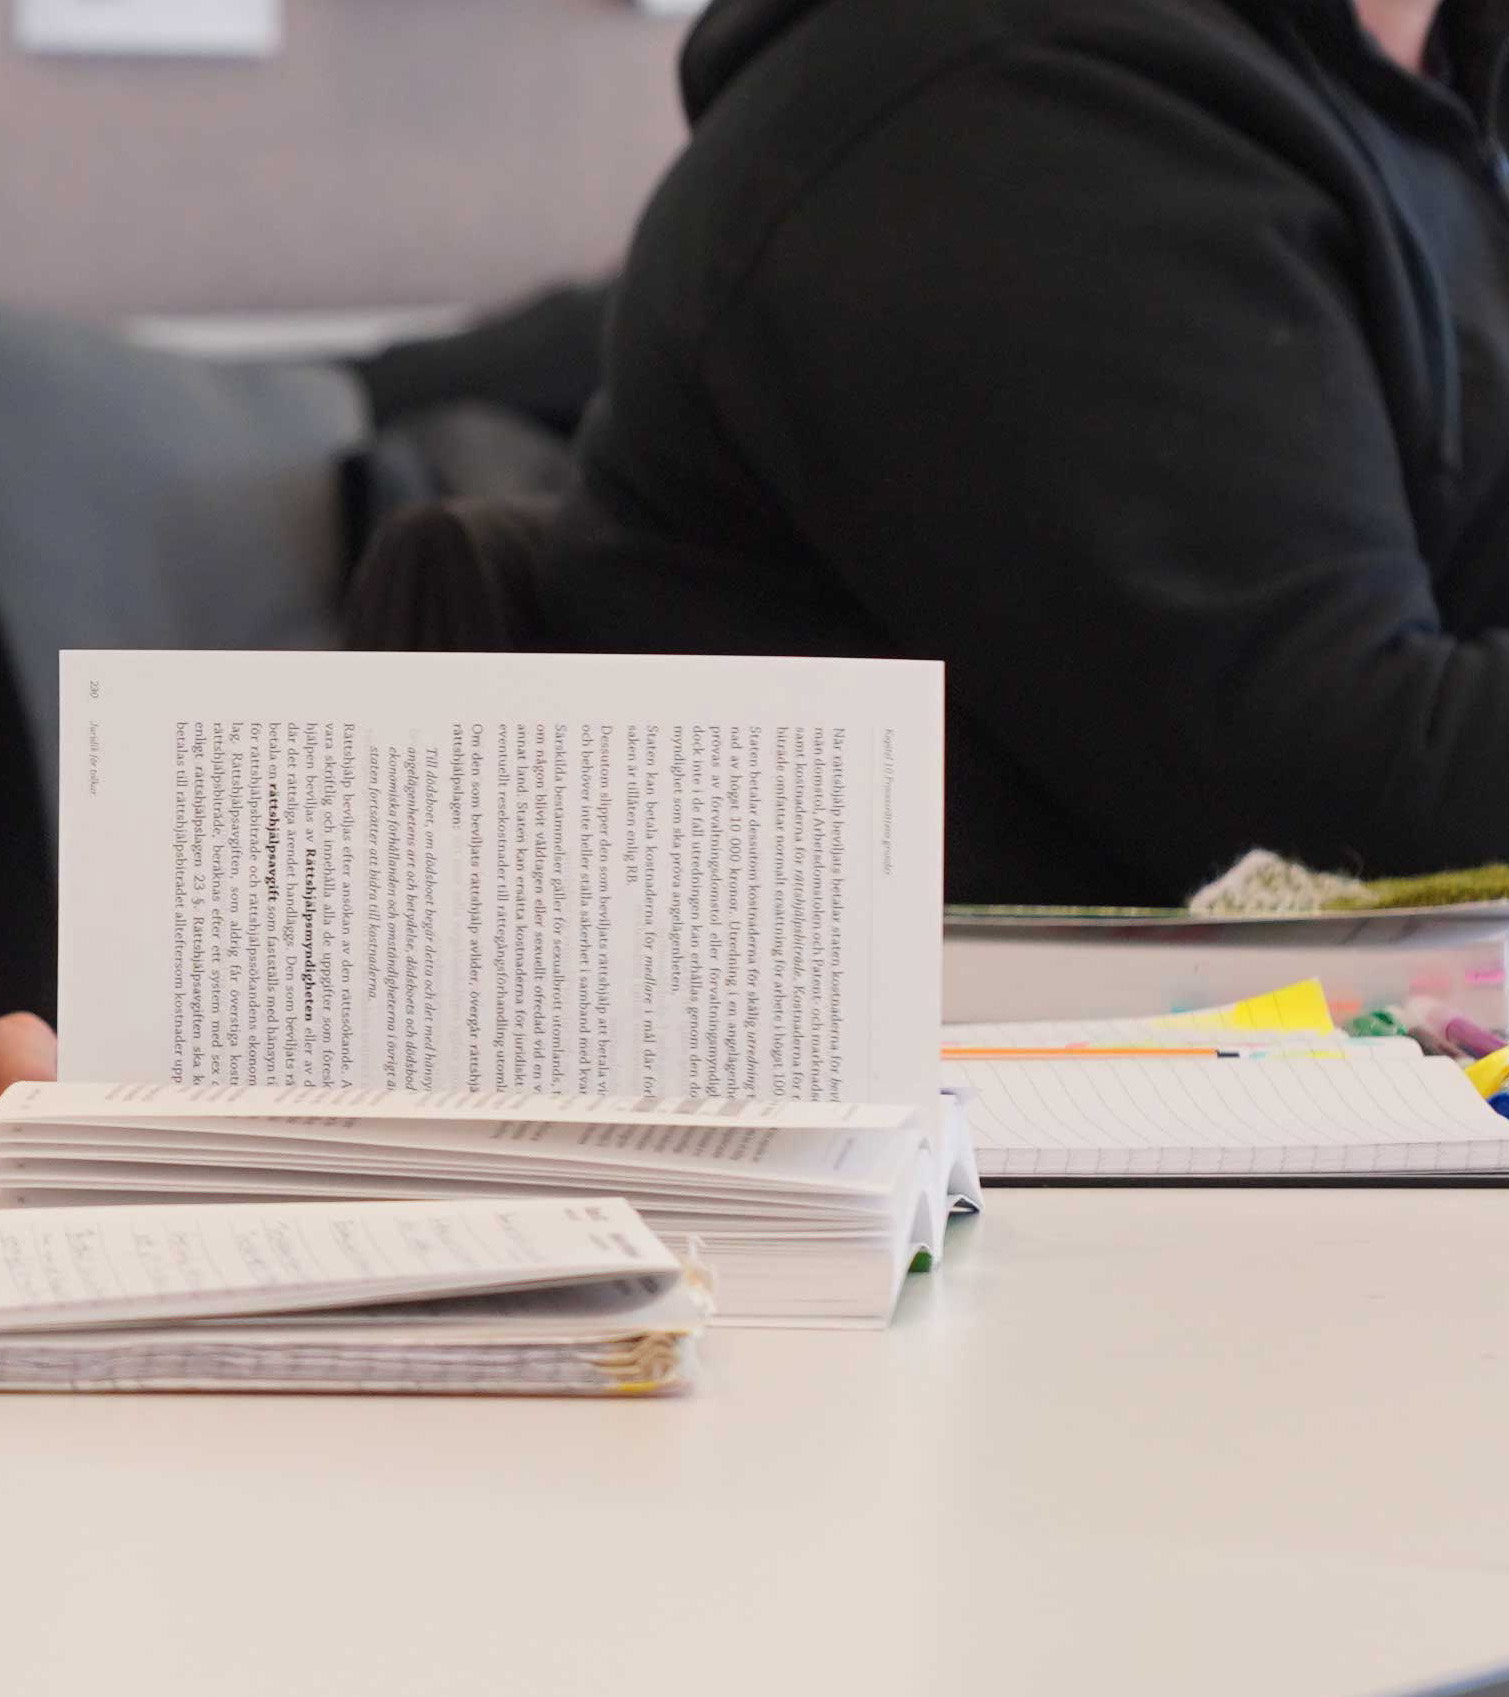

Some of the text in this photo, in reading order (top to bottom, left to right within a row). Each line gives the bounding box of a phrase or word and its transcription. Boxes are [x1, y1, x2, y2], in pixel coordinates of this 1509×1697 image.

[208, 722, 228, 1014] rättshjälpsbiträde, beräknas efter system
[319, 723, 338, 1011] vara skriftlig innehålla alla uppgifter
[421, 747, 439, 977] Till dödsboet, dödsboet begär detta
[449, 724, 466, 829] rättshjälpslagen:
[497, 723, 511, 787] eventuellt
[626, 781, 641, 827] tillåten
[627, 725, 641, 761] saken
[644, 725, 659, 1004] Staten betala kostnaderna medlare
[670, 725, 687, 793] myndighet
[774, 835, 789, 885] normalt
[775, 727, 789, 771] biträde
[775, 775, 789, 831] omfattar
[793, 763, 808, 842] kostnaderna
[794, 727, 806, 758] samt
[811, 758, 827, 815] domstol,
[172, 722, 190, 1056] betalas till rättshjälpsbiträdet allteftersom kostnader
[189, 722, 208, 1039] enligt rättshjälpslagen Rättshjälpsavgiften
[226, 753, 245, 1047] Rättshjälpsavgiften, aldrig överstiga
[245, 746, 264, 1030] rättshjälpsbiträde rättshjälpssökandens
[263, 722, 282, 1072] betala rättshjälpsavgift fastställs hänsyn
[282, 773, 301, 1069] rättsliga ärendet handläggs. beviljats
[301, 722, 320, 1055] hjälpen beviljas Rättshjälpsmyndigheten eller
[338, 723, 356, 1074] Rättshjälp beviljas efter ansökan rättssökande.
[369, 745, 383, 1001] staten fortsätter bidra till kostnaderna.
[383, 746, 403, 1077] ekonomiska förhållanden omständigheterna övrigt
[403, 747, 420, 1015] angelägenhetens betydelse, dödsboets
[466, 813, 484, 1039] beviljats rättshjälp avlider, övergår
[493, 905, 510, 1047] rättegångsförhandling
[497, 884, 510, 901] till
[511, 723, 530, 1087] annat land. Staten ersätta kostnaderna juridiskt
[531, 749, 549, 1035] någon blivit våldtagen eller sexuellt ofredad
[550, 724, 568, 1087] Särskilda bestämmelser gäller sexualbrott utomlands,
[579, 750, 595, 1033] behöver inte heller ställa säkerhet samband
[595, 725, 613, 1078] Dessutom slipper beviljats rättshjälp betala
[686, 725, 706, 1049] dock fall utredningen erhållas genom
[709, 932, 723, 960] eller
[724, 921, 742, 987] Utredning
[727, 867, 742, 914] kronor.
[743, 726, 762, 1091] Staten betalar dessutom kostnaderna skälig utredning
[771, 890, 787, 956] ersättning
[829, 755, 846, 1051] rättshjälp beviljats betalar staten kostnaderna
[773, 981, 788, 1022] arbete
[792, 985, 807, 1067] Kostnaderna
